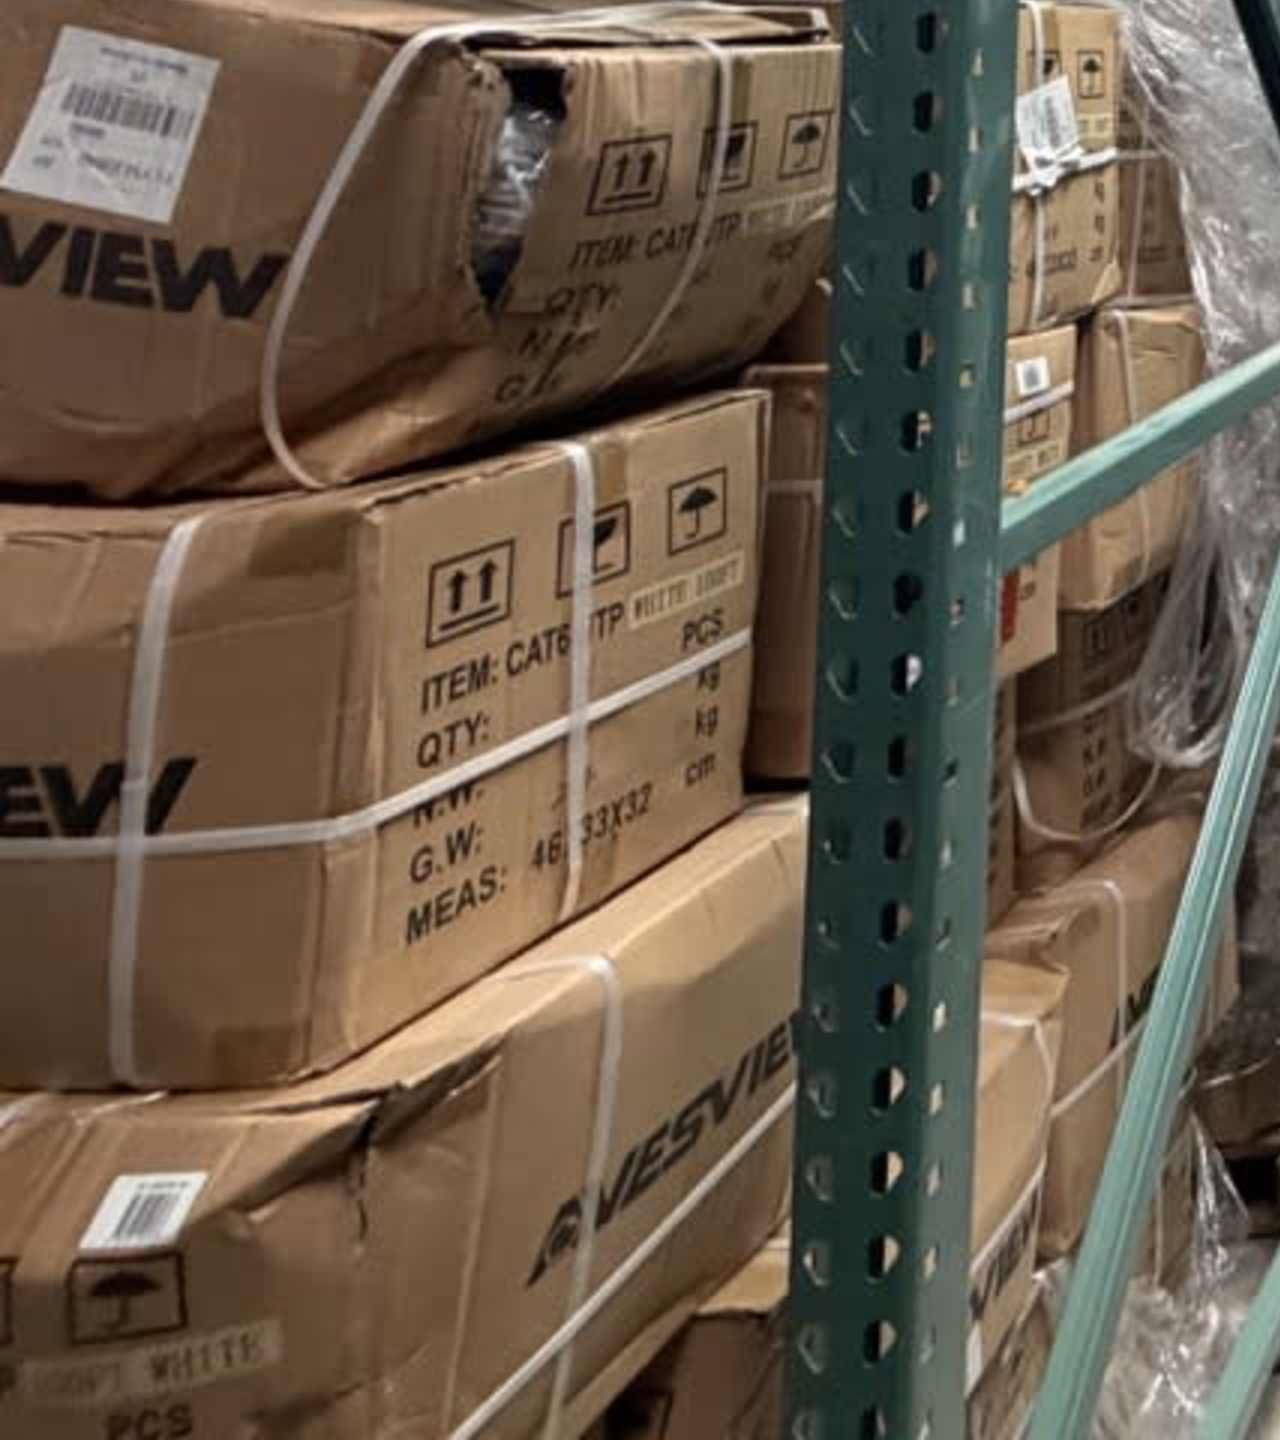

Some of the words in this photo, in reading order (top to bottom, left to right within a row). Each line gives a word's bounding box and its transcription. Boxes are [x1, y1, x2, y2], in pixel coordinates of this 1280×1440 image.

[419, 657, 499, 717] ITEM:
[590, 601, 626, 643] TP
[416, 712, 491, 770] QTY:
[404, 866, 509, 947] MEAS:
[529, 781, 655, 873] 4633X32
[409, 821, 483, 886] G.W:
